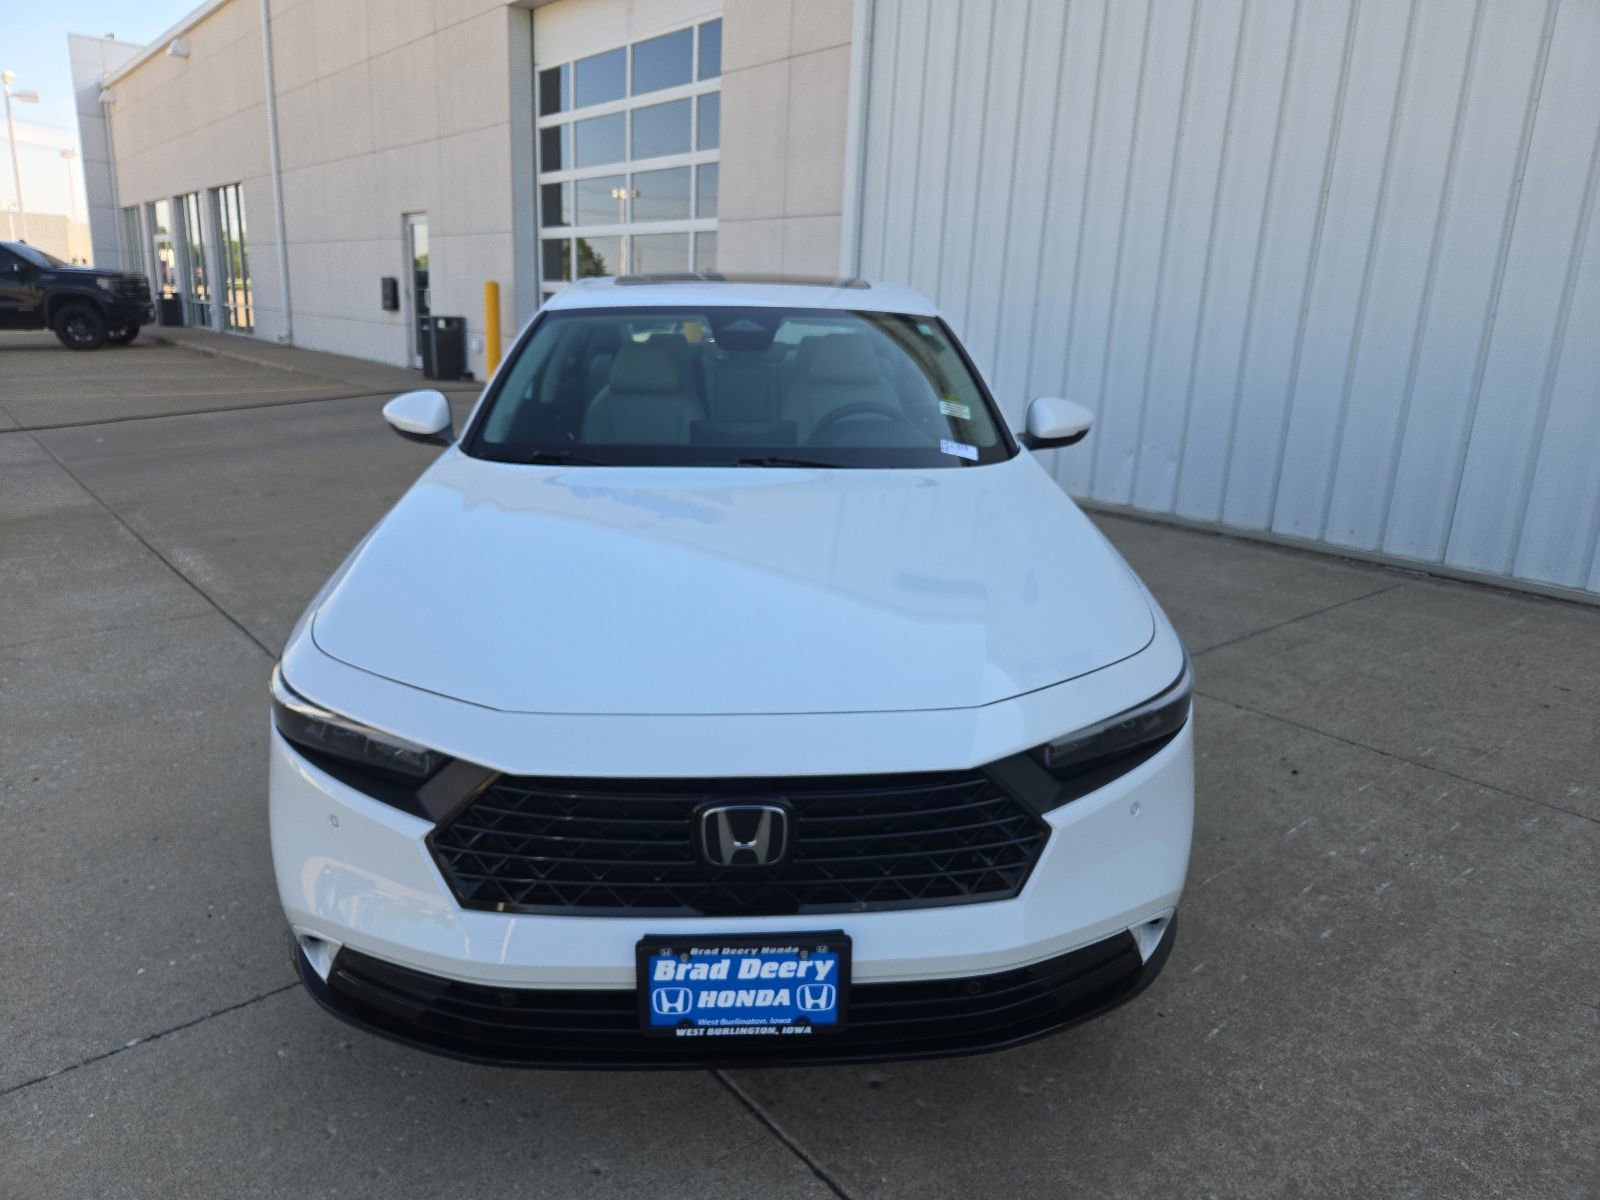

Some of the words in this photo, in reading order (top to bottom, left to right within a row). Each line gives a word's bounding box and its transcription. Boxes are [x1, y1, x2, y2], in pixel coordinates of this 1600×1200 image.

[689, 947, 719, 956] Brad
[721, 946, 759, 955] Deery
[760, 946, 799, 954] Honda
[653, 959, 731, 981] Brad
[737, 958, 835, 981] Deery
[697, 988, 791, 1009] HONDA
[697, 1018, 719, 1026] West
[675, 1028, 706, 1037] WEST
[781, 1026, 813, 1034] IOWA
